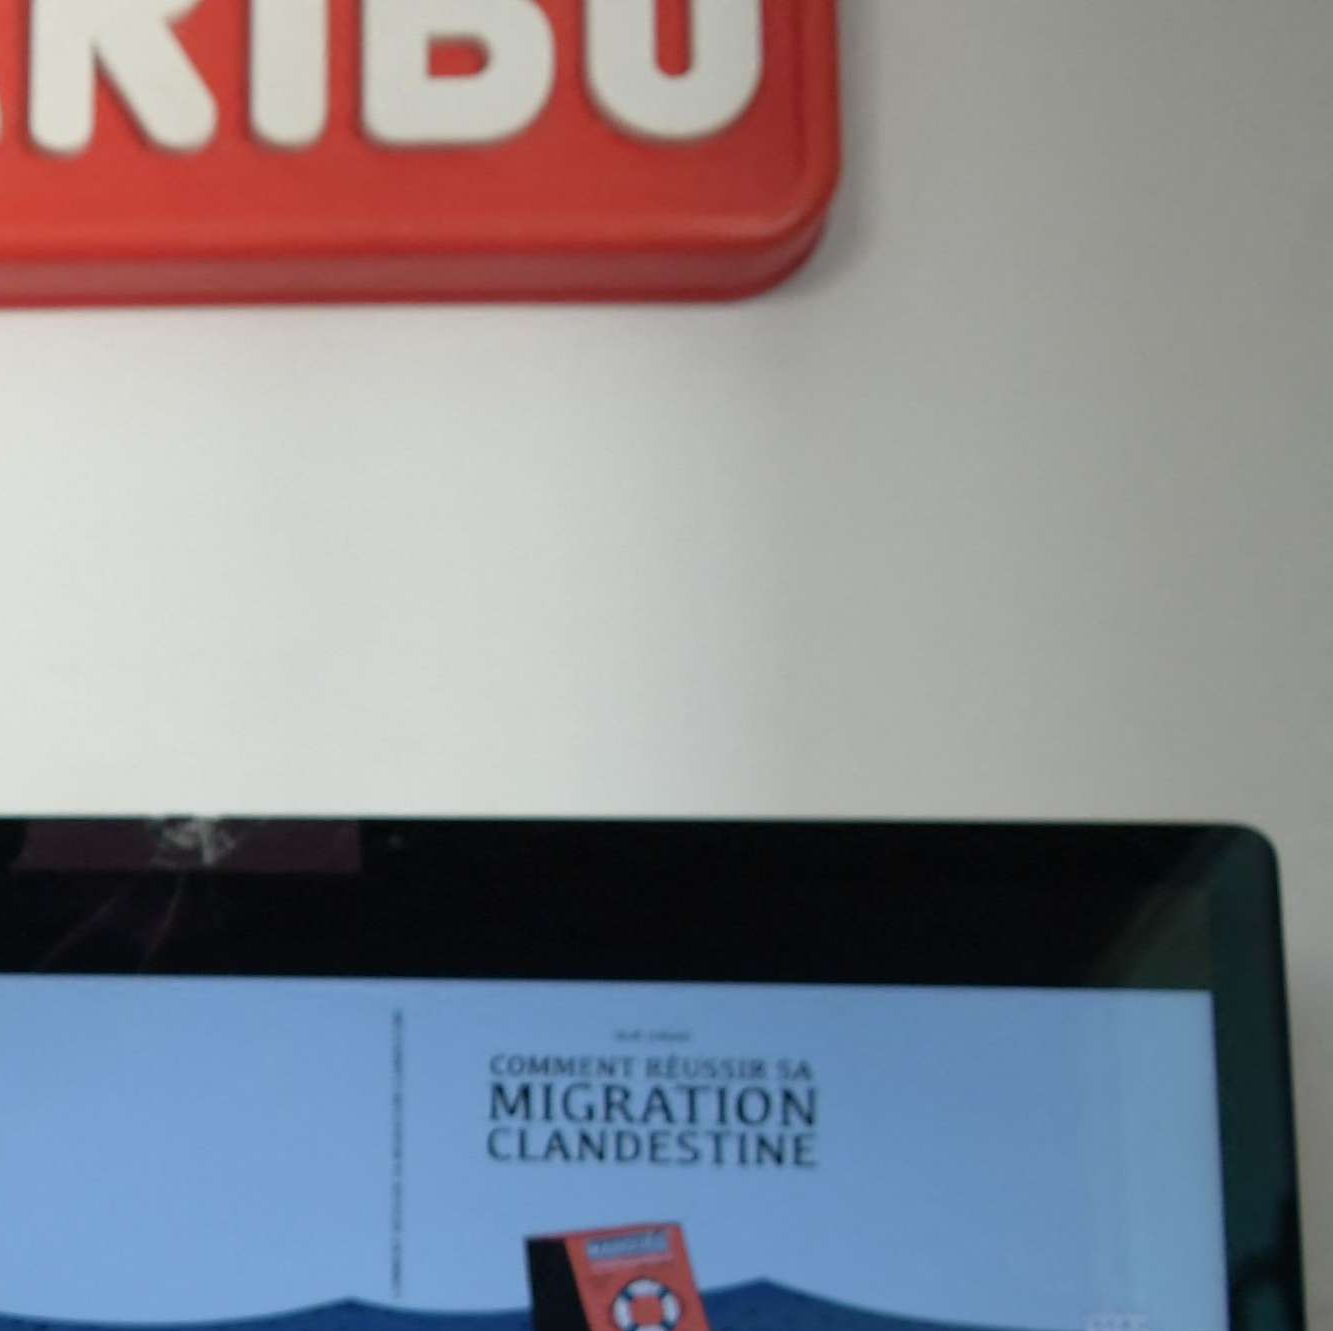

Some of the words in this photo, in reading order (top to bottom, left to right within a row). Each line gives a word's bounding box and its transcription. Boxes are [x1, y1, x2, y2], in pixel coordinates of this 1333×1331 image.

[489, 1053, 634, 1078] COMMENT
[644, 1053, 766, 1082] RÉUSSIR
[776, 1060, 814, 1082] SA
[487, 1082, 817, 1128] MIGRATION
[486, 1128, 818, 1168] CLANDESTINE
